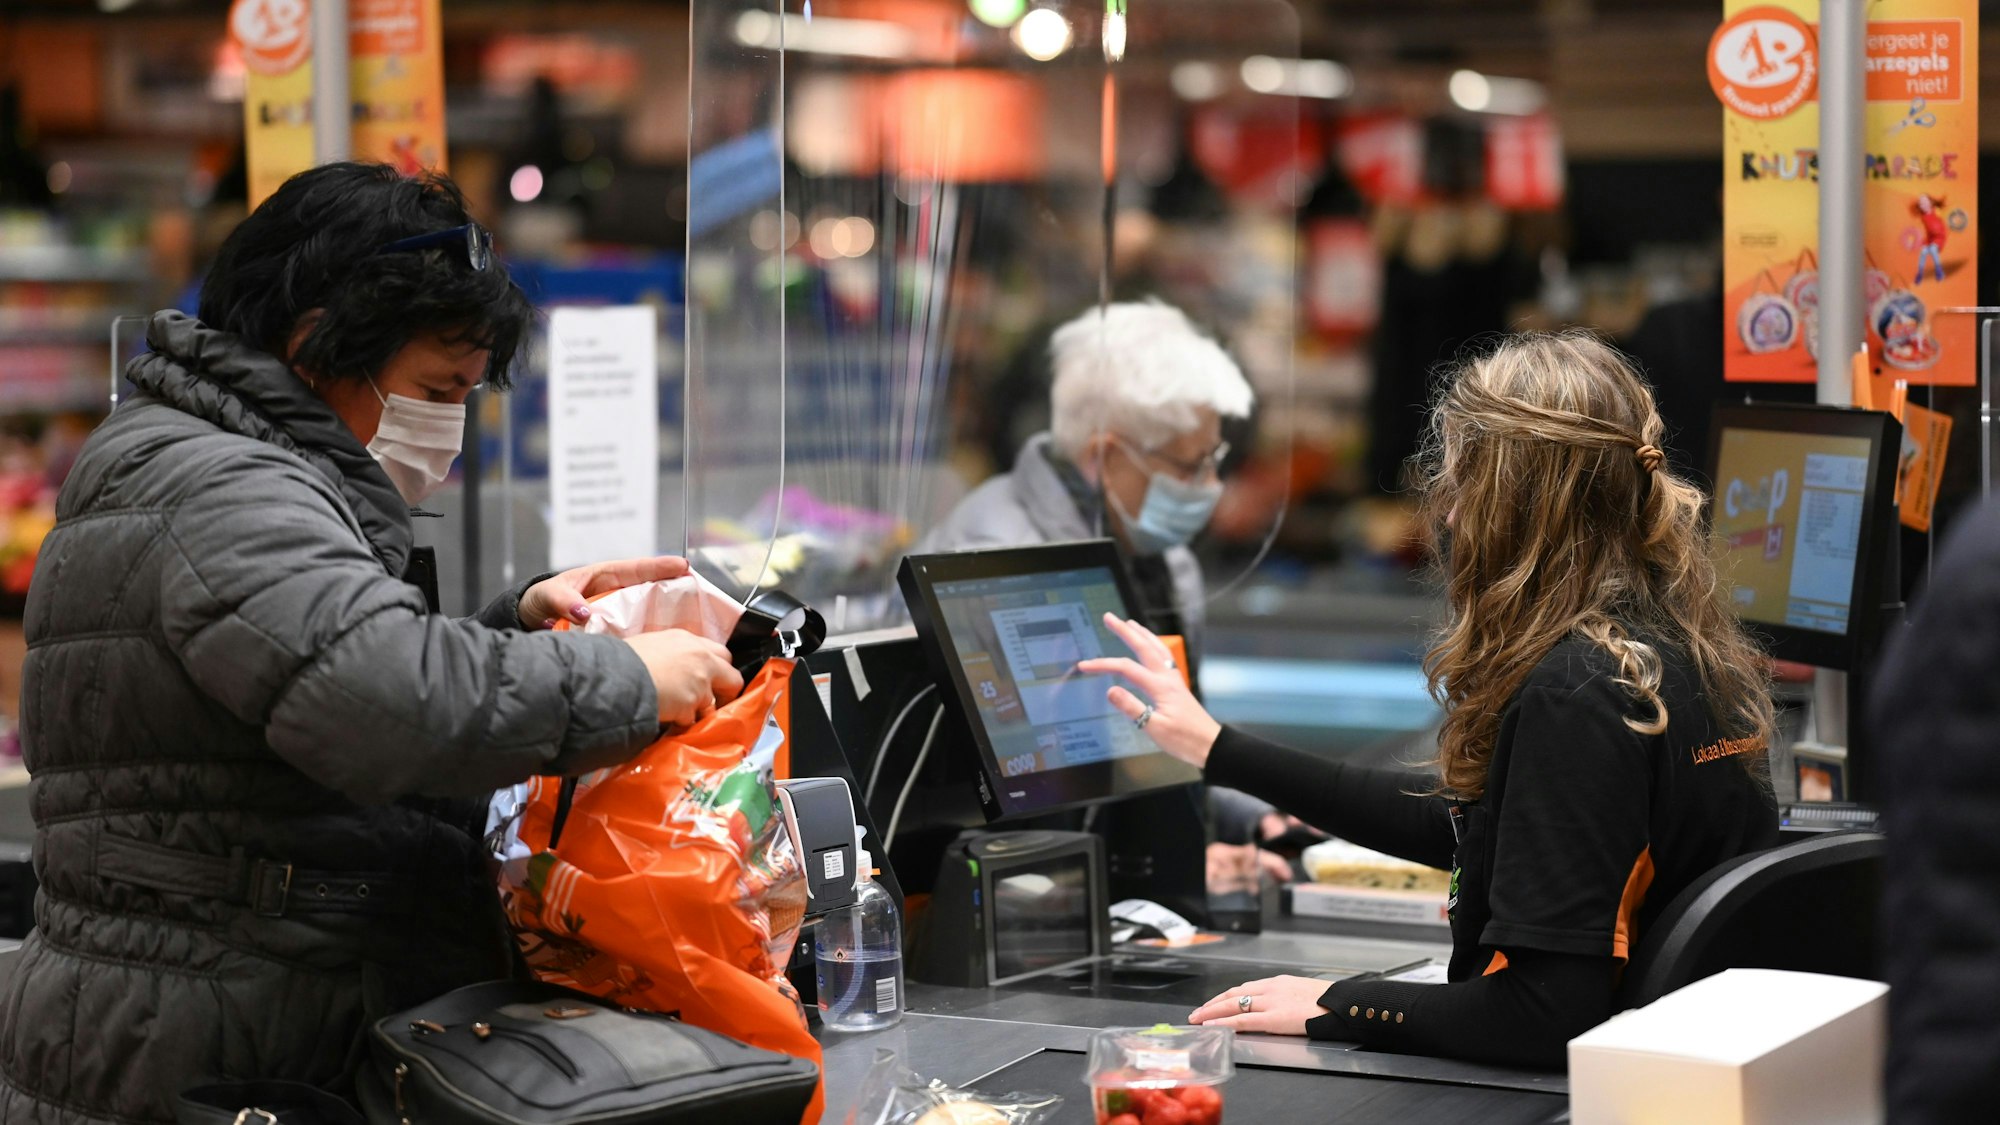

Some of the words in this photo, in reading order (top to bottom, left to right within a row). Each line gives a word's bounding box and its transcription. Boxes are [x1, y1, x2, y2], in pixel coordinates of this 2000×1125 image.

[1867, 32, 1926, 54] ergeet
[1930, 31, 1949, 52] je
[1866, 52, 1949, 76] arzegels
[1906, 75, 1948, 94] niet!
[1006, 752, 1036, 777] coop
[1691, 742, 1721, 766] Lokaal
